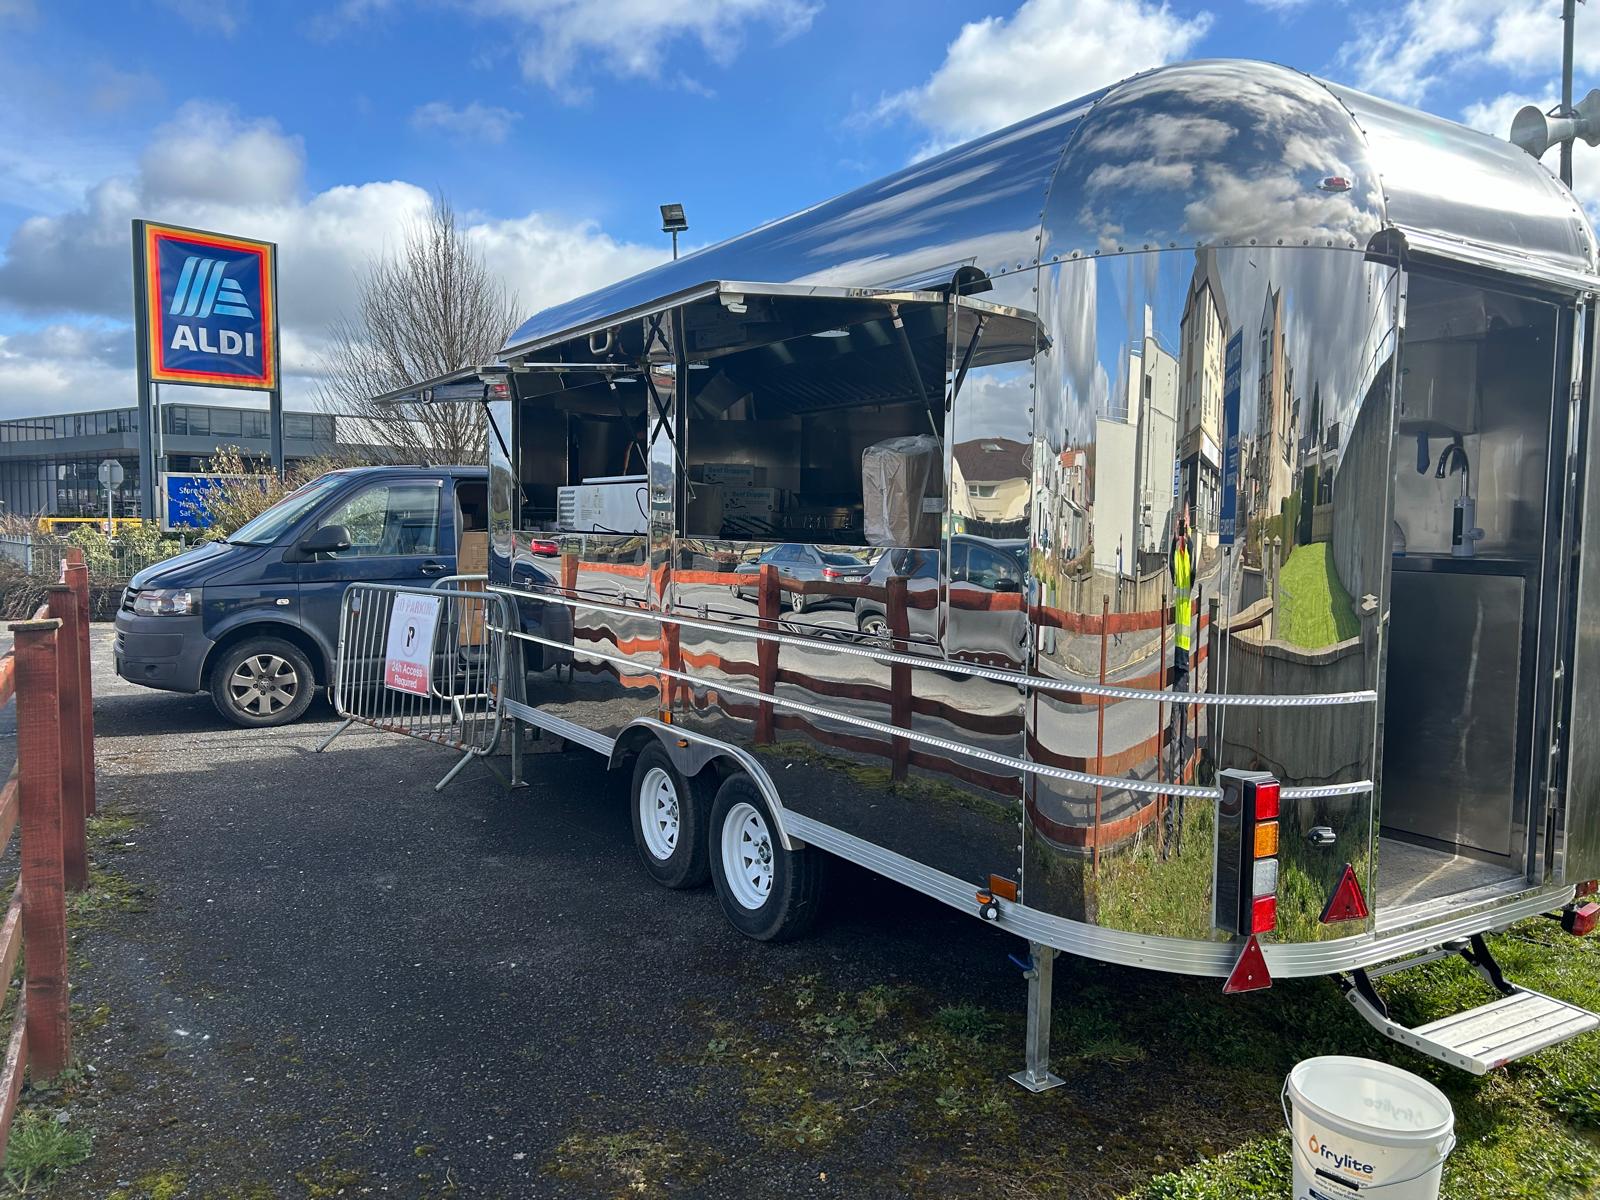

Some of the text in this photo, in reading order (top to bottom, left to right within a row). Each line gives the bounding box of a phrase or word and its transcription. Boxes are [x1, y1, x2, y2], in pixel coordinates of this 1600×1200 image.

[170, 324, 254, 357] ALDI
[391, 662, 423, 678] 24h Access
[394, 674, 418, 689] Required
[1320, 1144, 1374, 1174] frylite
